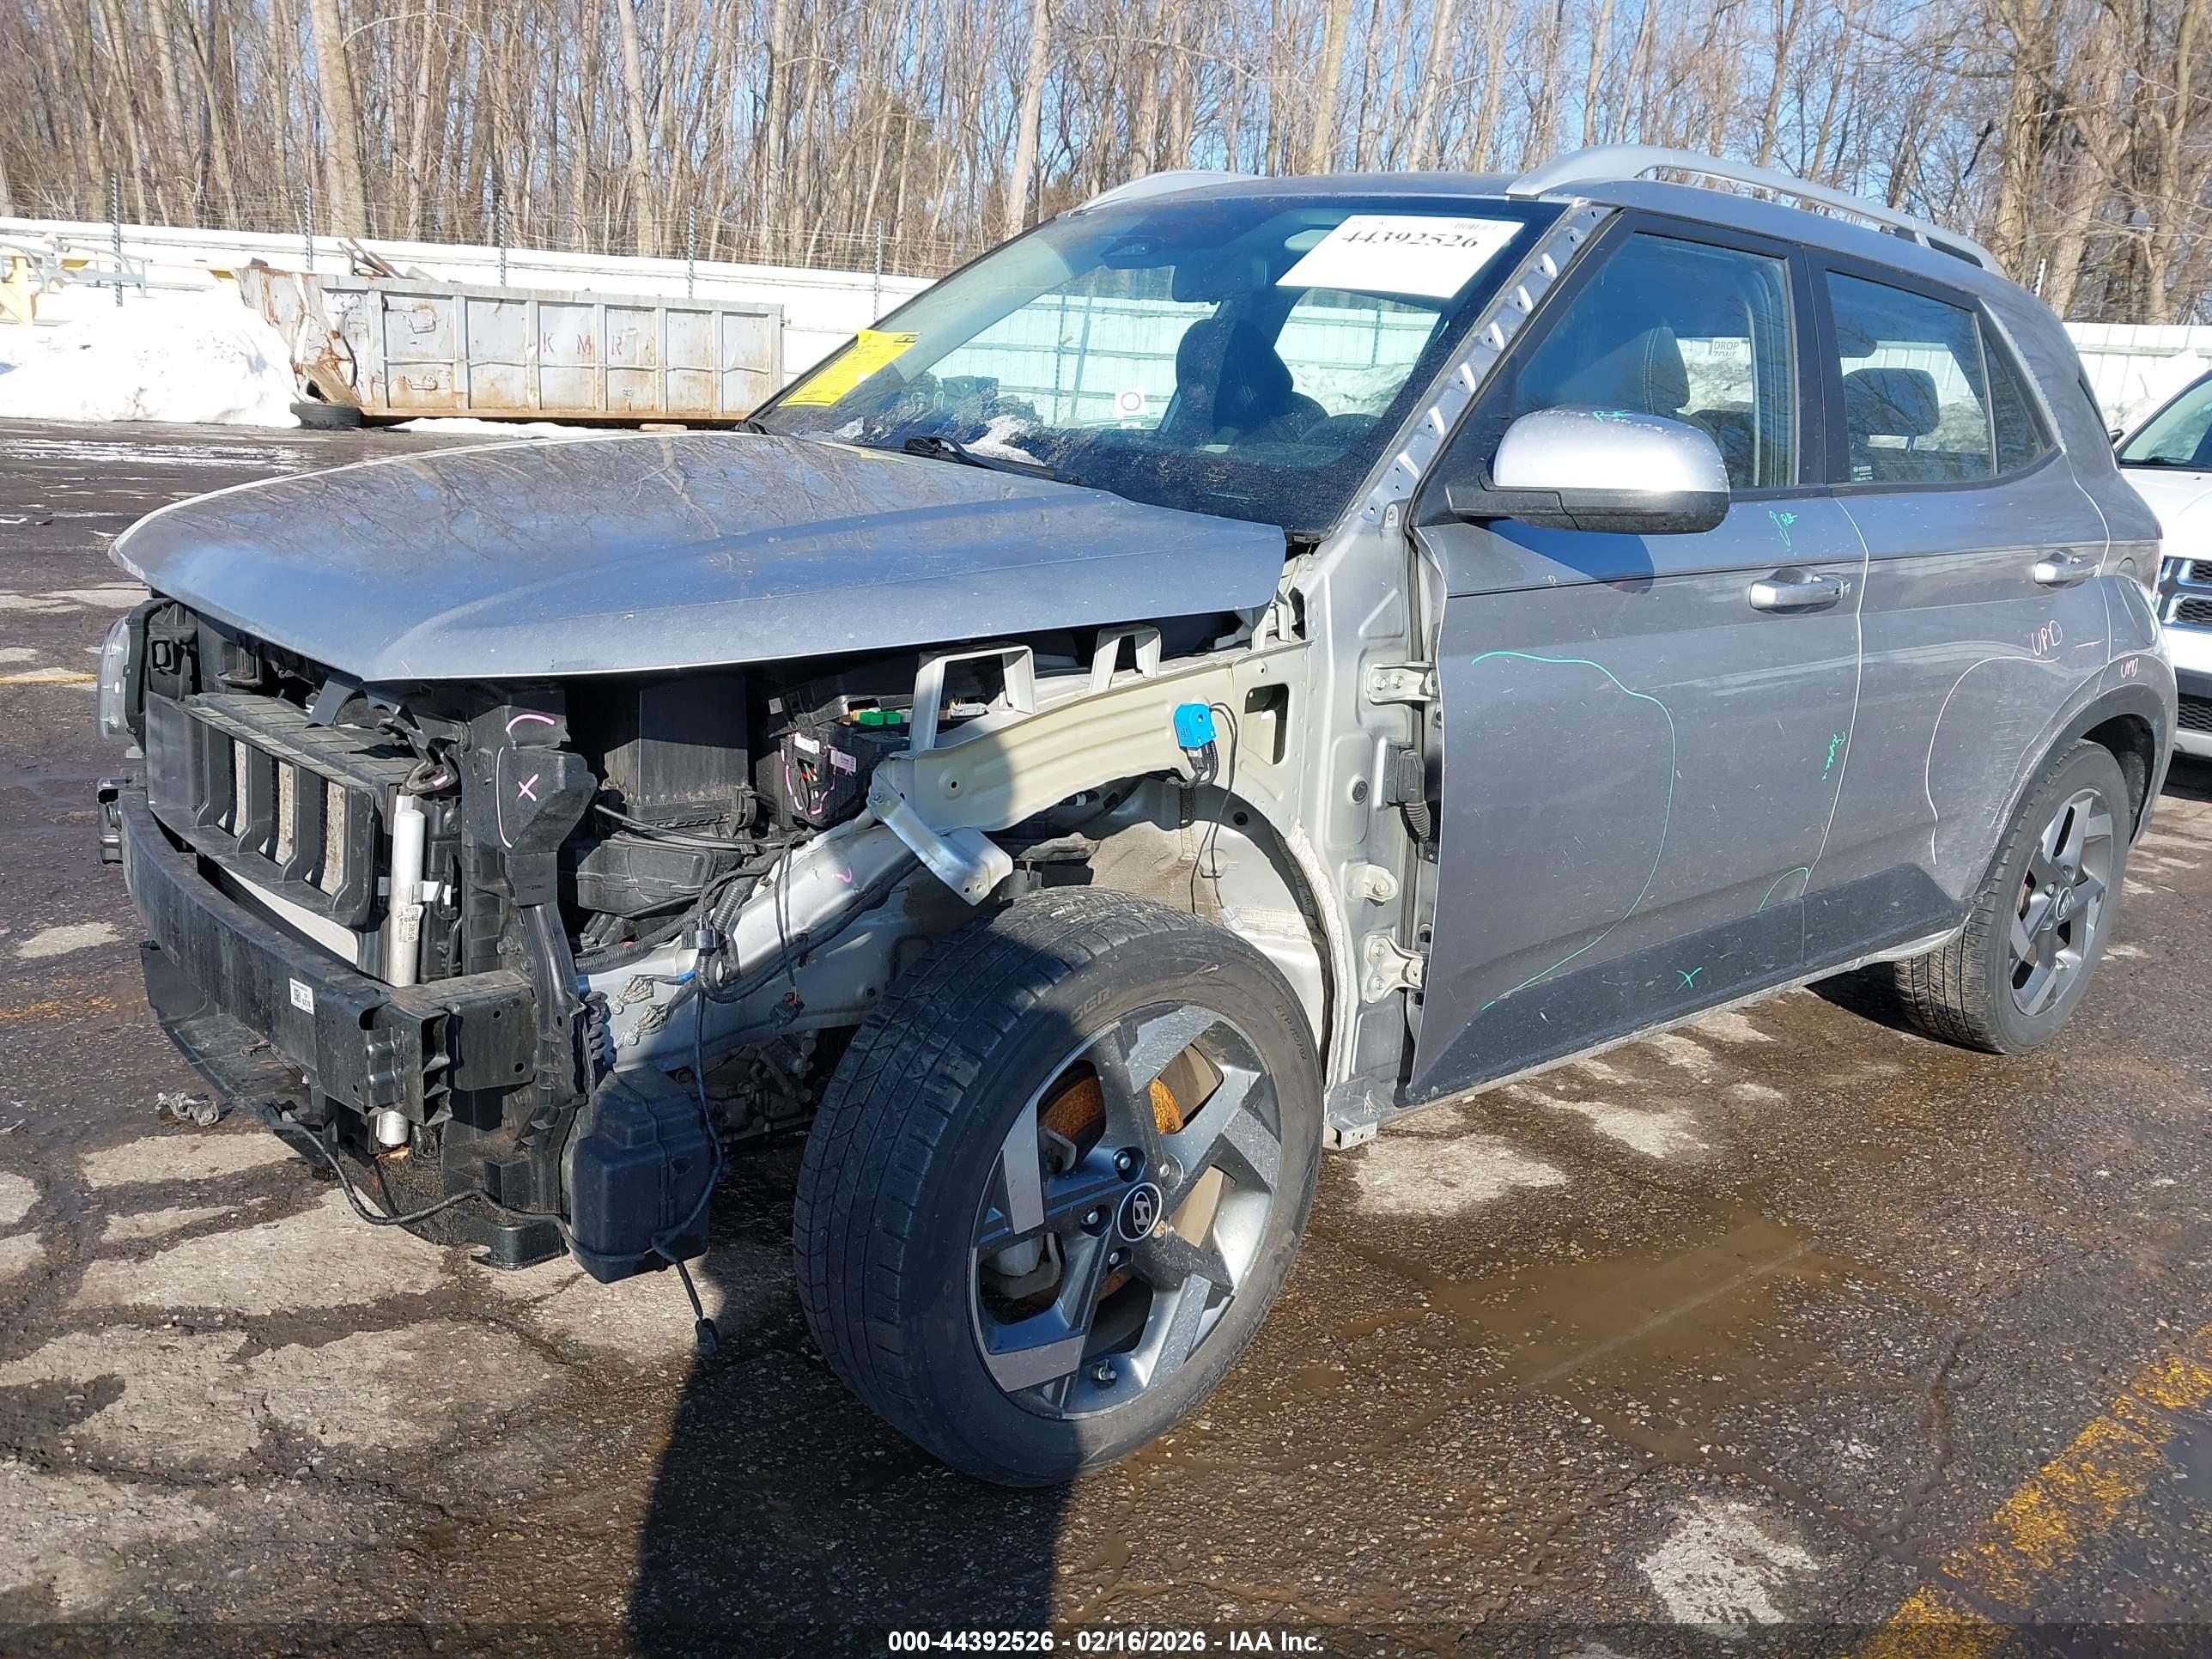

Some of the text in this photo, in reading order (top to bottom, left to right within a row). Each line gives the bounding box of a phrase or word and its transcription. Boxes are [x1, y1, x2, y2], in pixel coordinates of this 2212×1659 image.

[1342, 230, 1479, 248] 44392526
[1714, 341, 1740, 350] DROP
[2032, 619, 2063, 656] UPD
